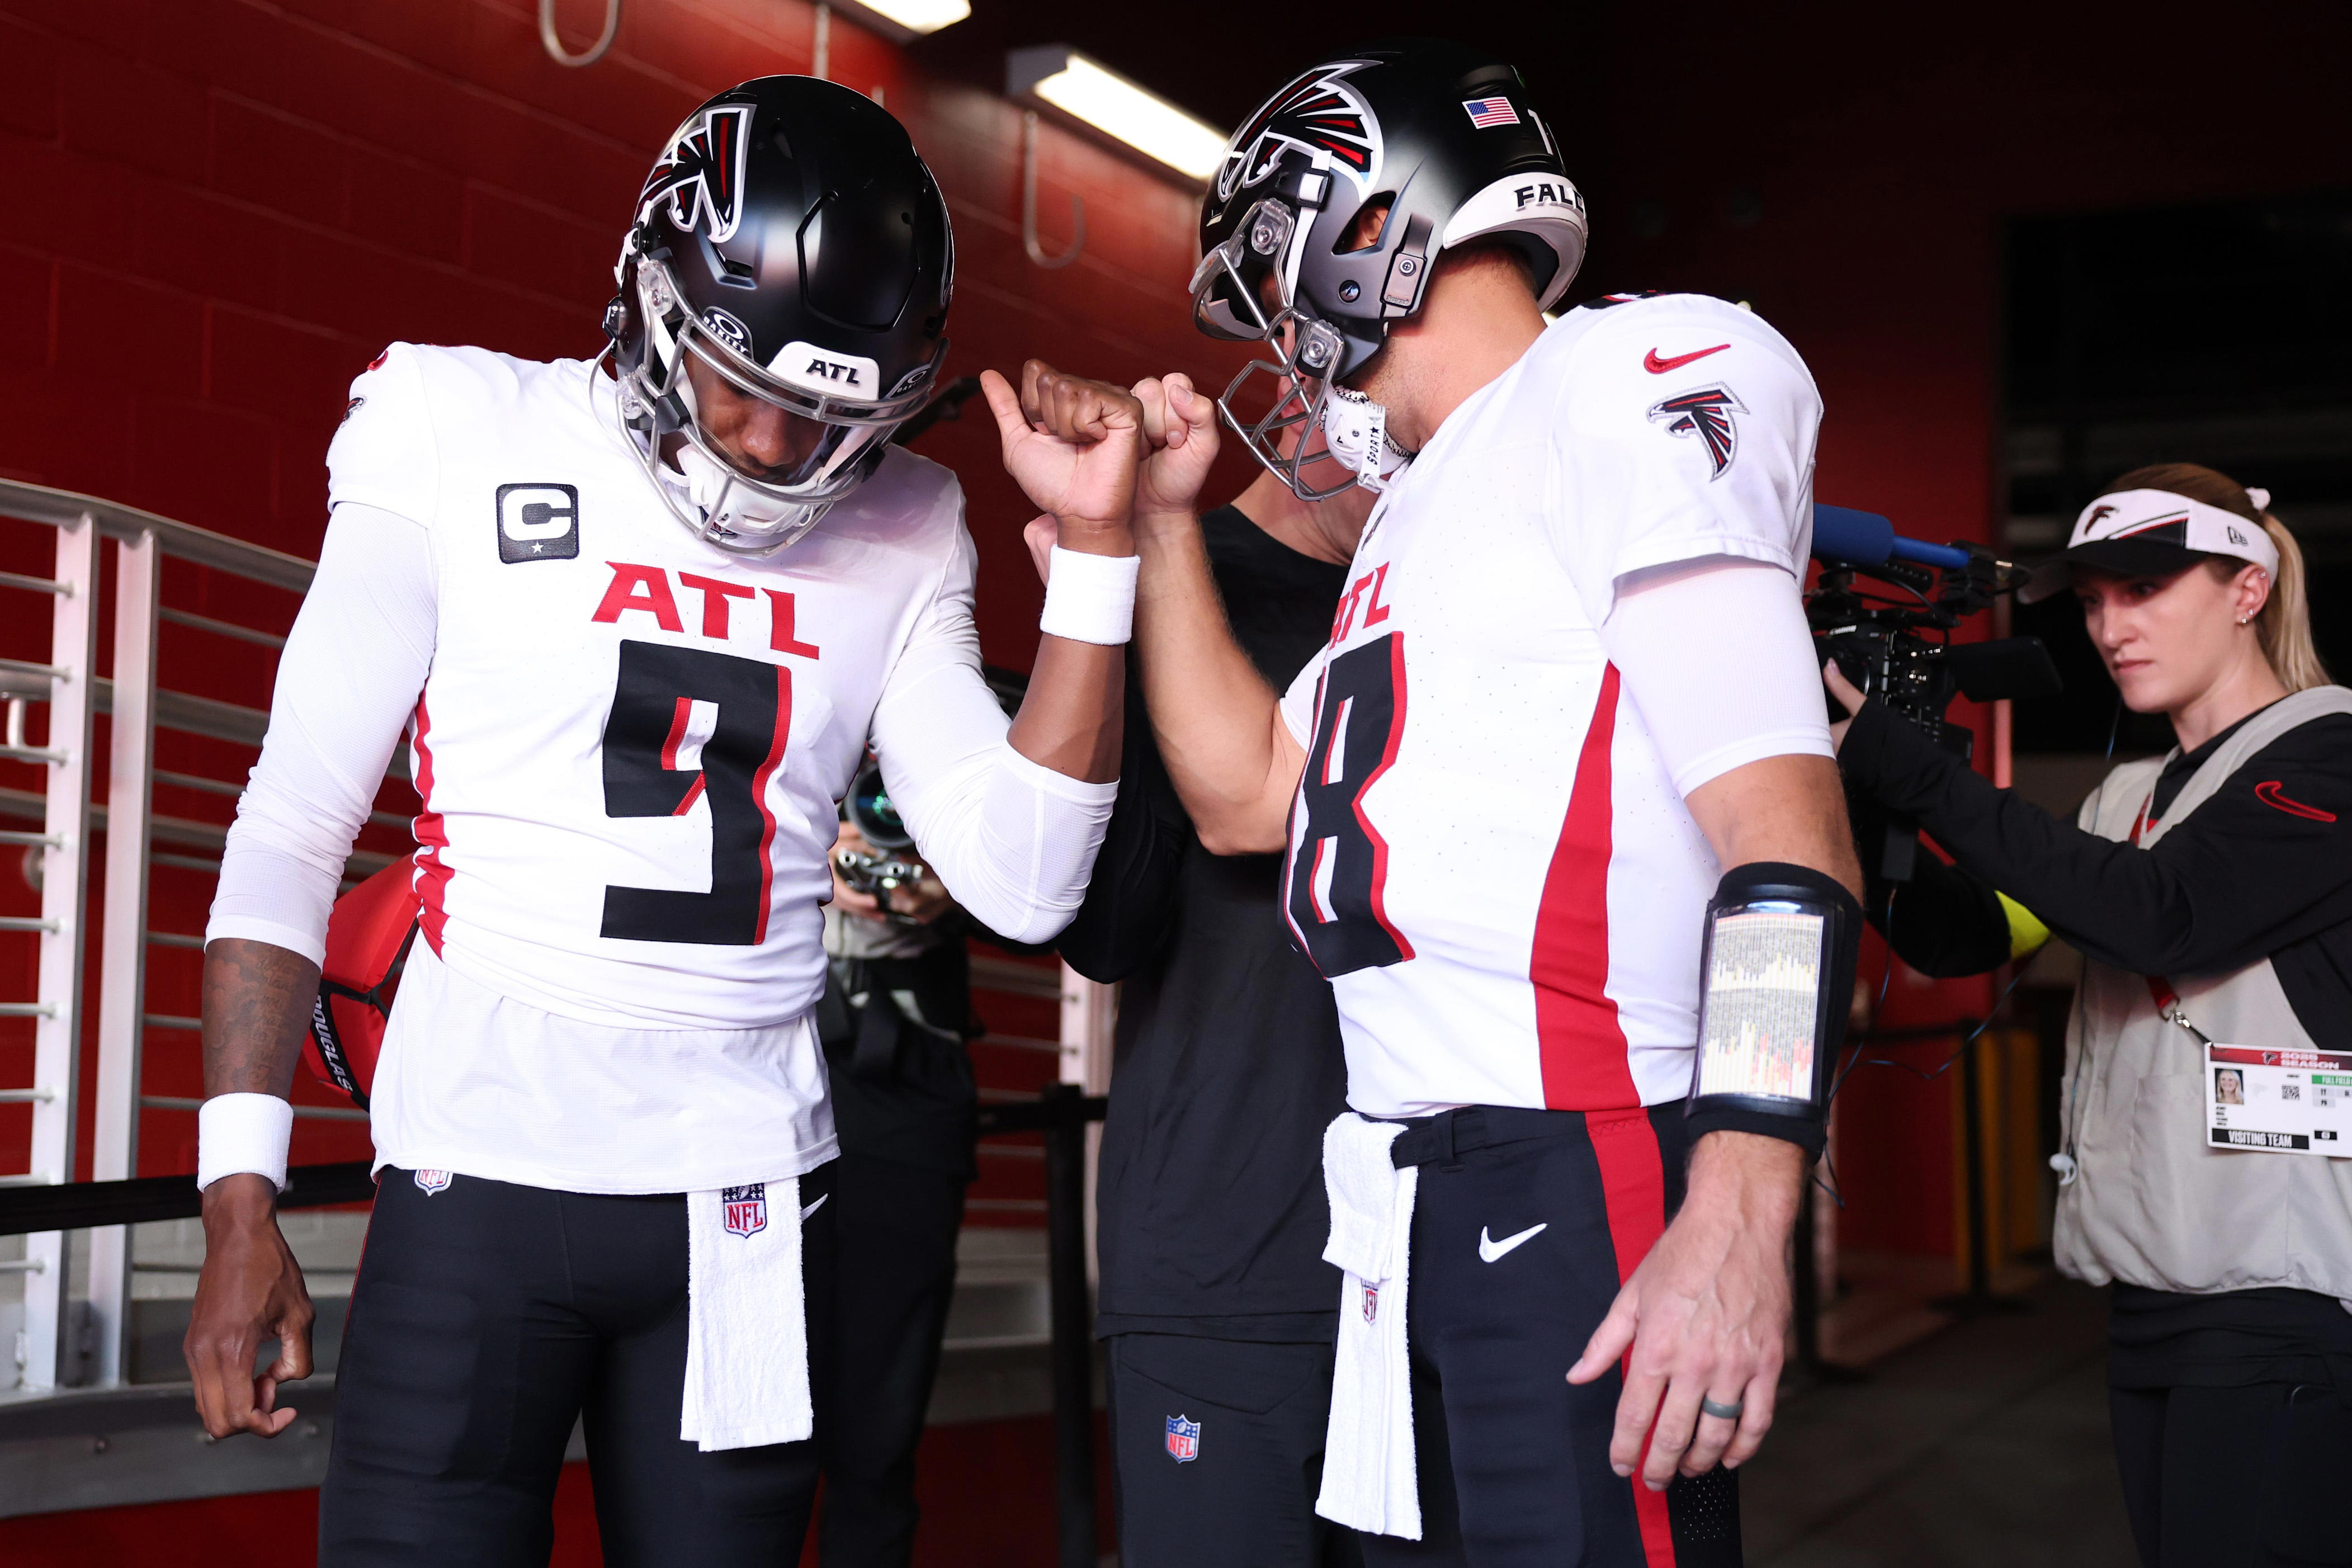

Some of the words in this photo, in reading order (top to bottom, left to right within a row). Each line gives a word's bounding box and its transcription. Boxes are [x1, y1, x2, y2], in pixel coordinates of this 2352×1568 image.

[703, 316, 748, 353] OAKLEY
[806, 359, 860, 385] ATL
[503, 489, 572, 541] C
[592, 560, 820, 660] ATL
[599, 639, 792, 946] 9
[2280, 1059, 2340, 1070] SEASON
[2228, 1130, 2266, 1146] VISITING
[2267, 1134, 2292, 1148] TEAM
[727, 1202, 764, 1232] NFL
[1168, 1433, 1193, 1457] NFL
